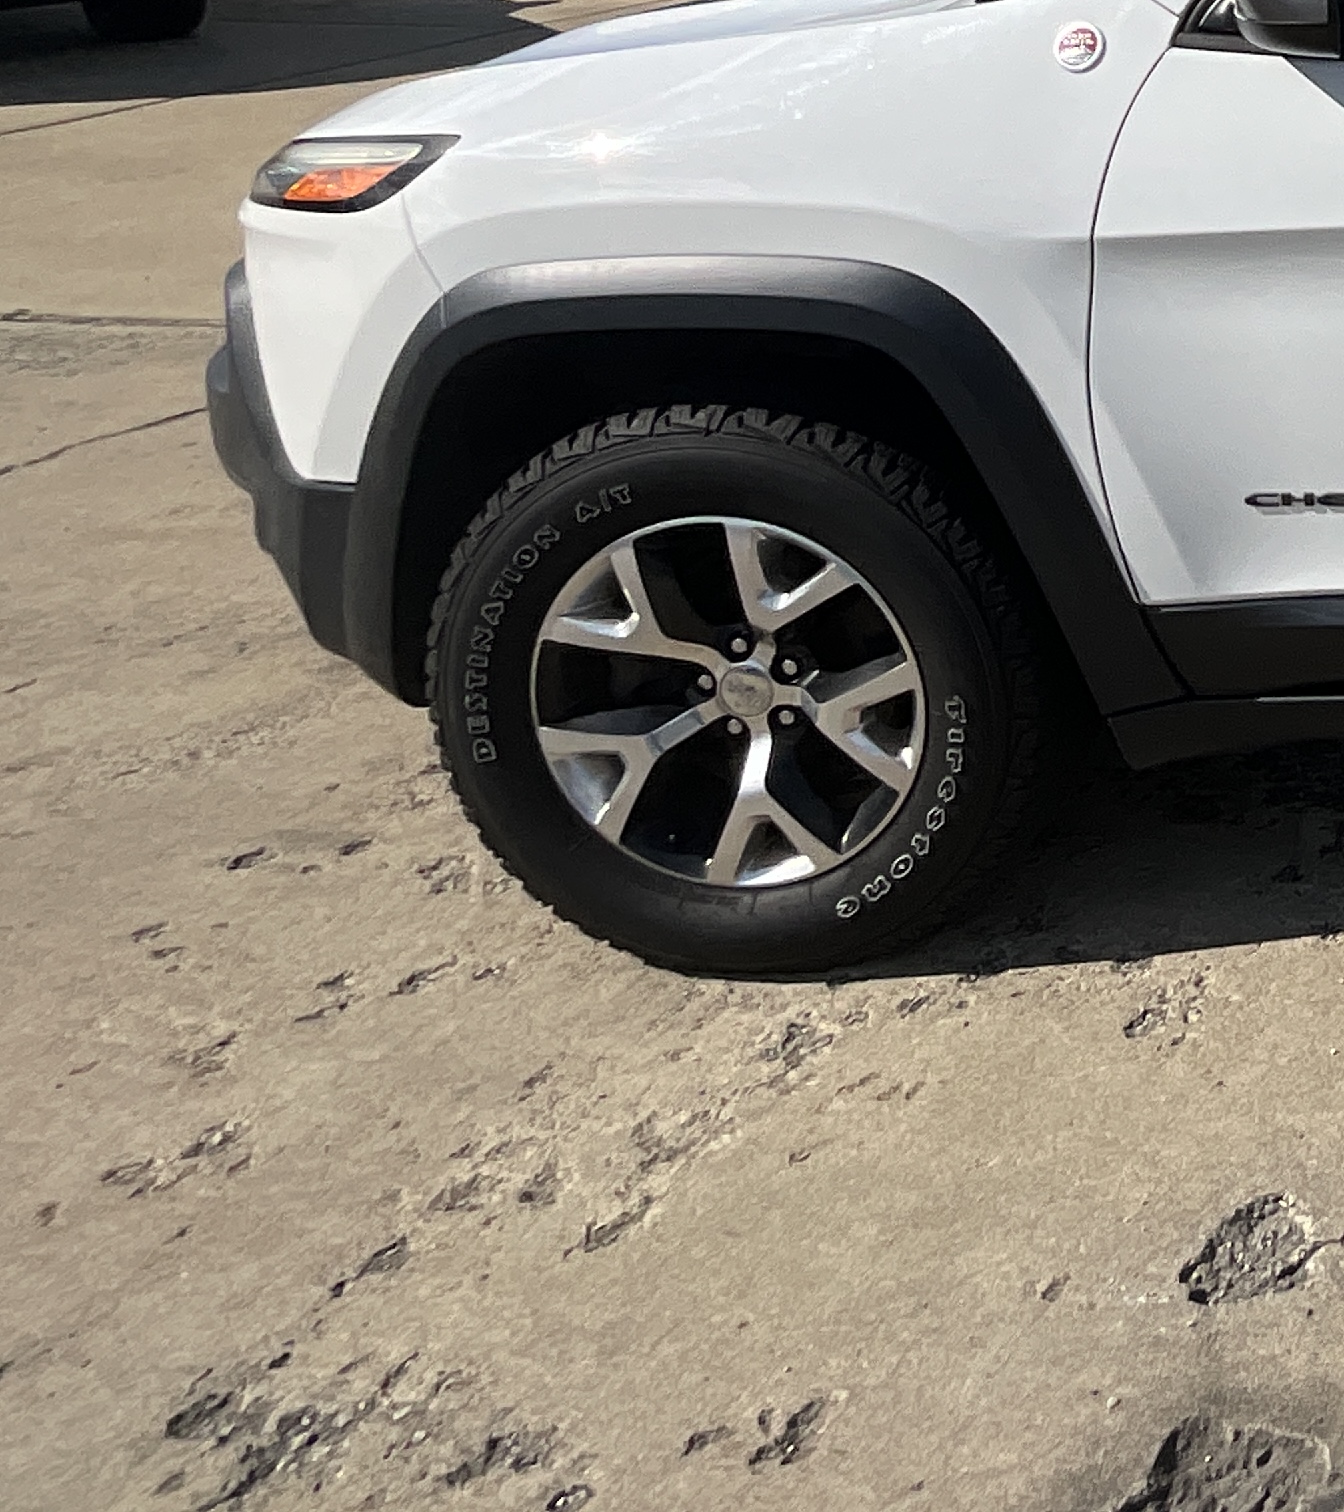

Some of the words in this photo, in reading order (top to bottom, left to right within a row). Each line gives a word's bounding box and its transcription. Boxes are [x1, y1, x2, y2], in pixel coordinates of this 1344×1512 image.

[463, 524, 562, 764] DESTINATION
[574, 483, 633, 524] A/T
[835, 694, 967, 919] Firestone
